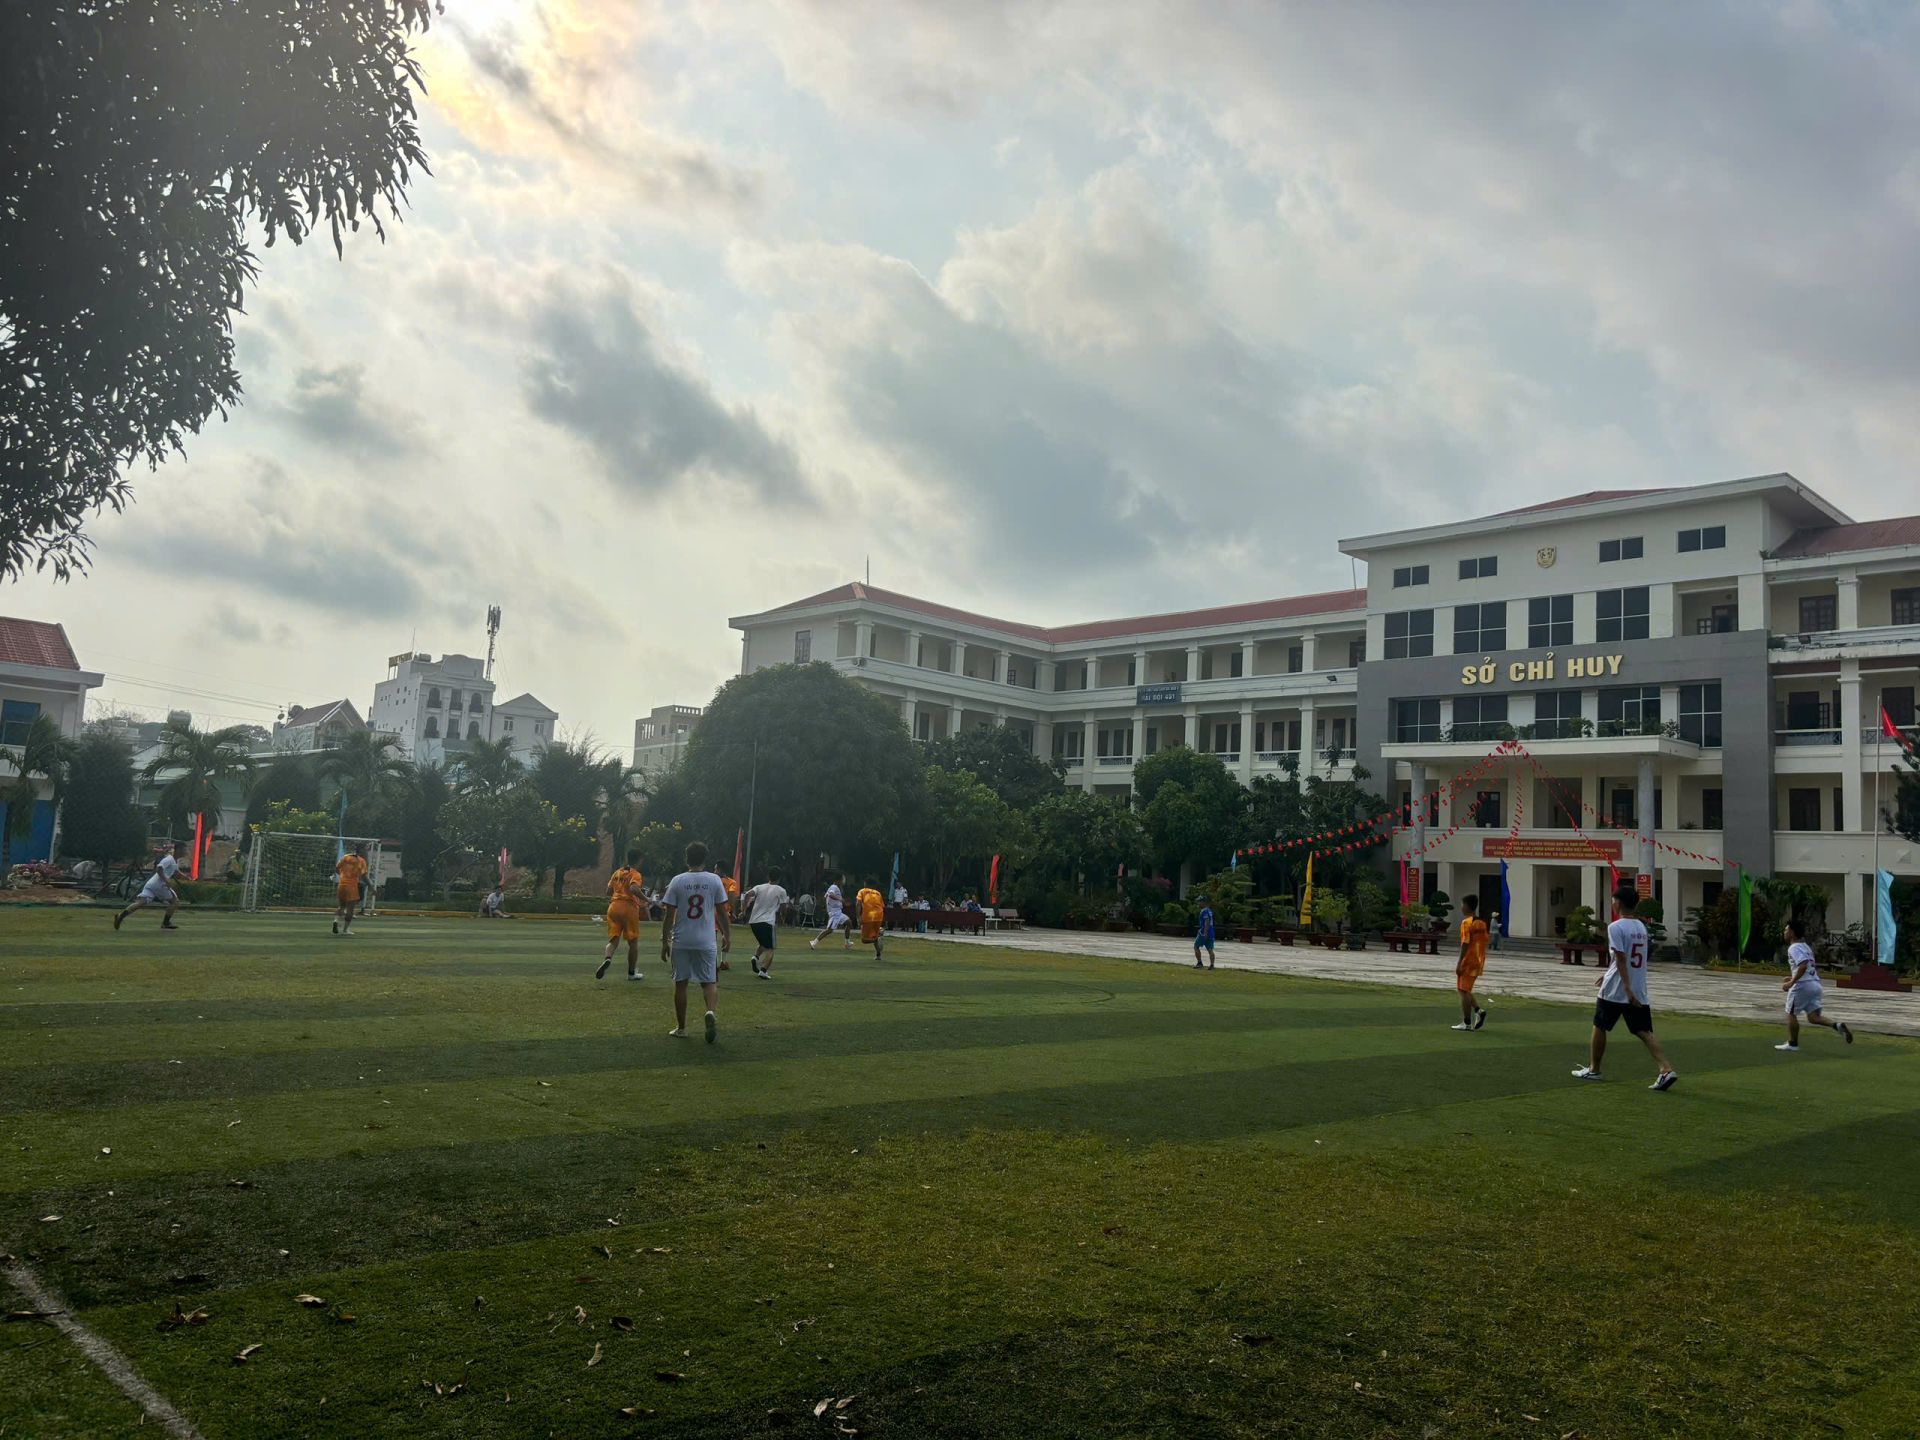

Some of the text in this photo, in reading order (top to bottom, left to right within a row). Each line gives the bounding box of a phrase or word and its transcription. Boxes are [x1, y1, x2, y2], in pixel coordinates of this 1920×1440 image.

[1461, 651, 1624, 685] SỞ CHỈ HUY
[687, 894, 704, 920] 8
[1631, 943, 1643, 969] 5
